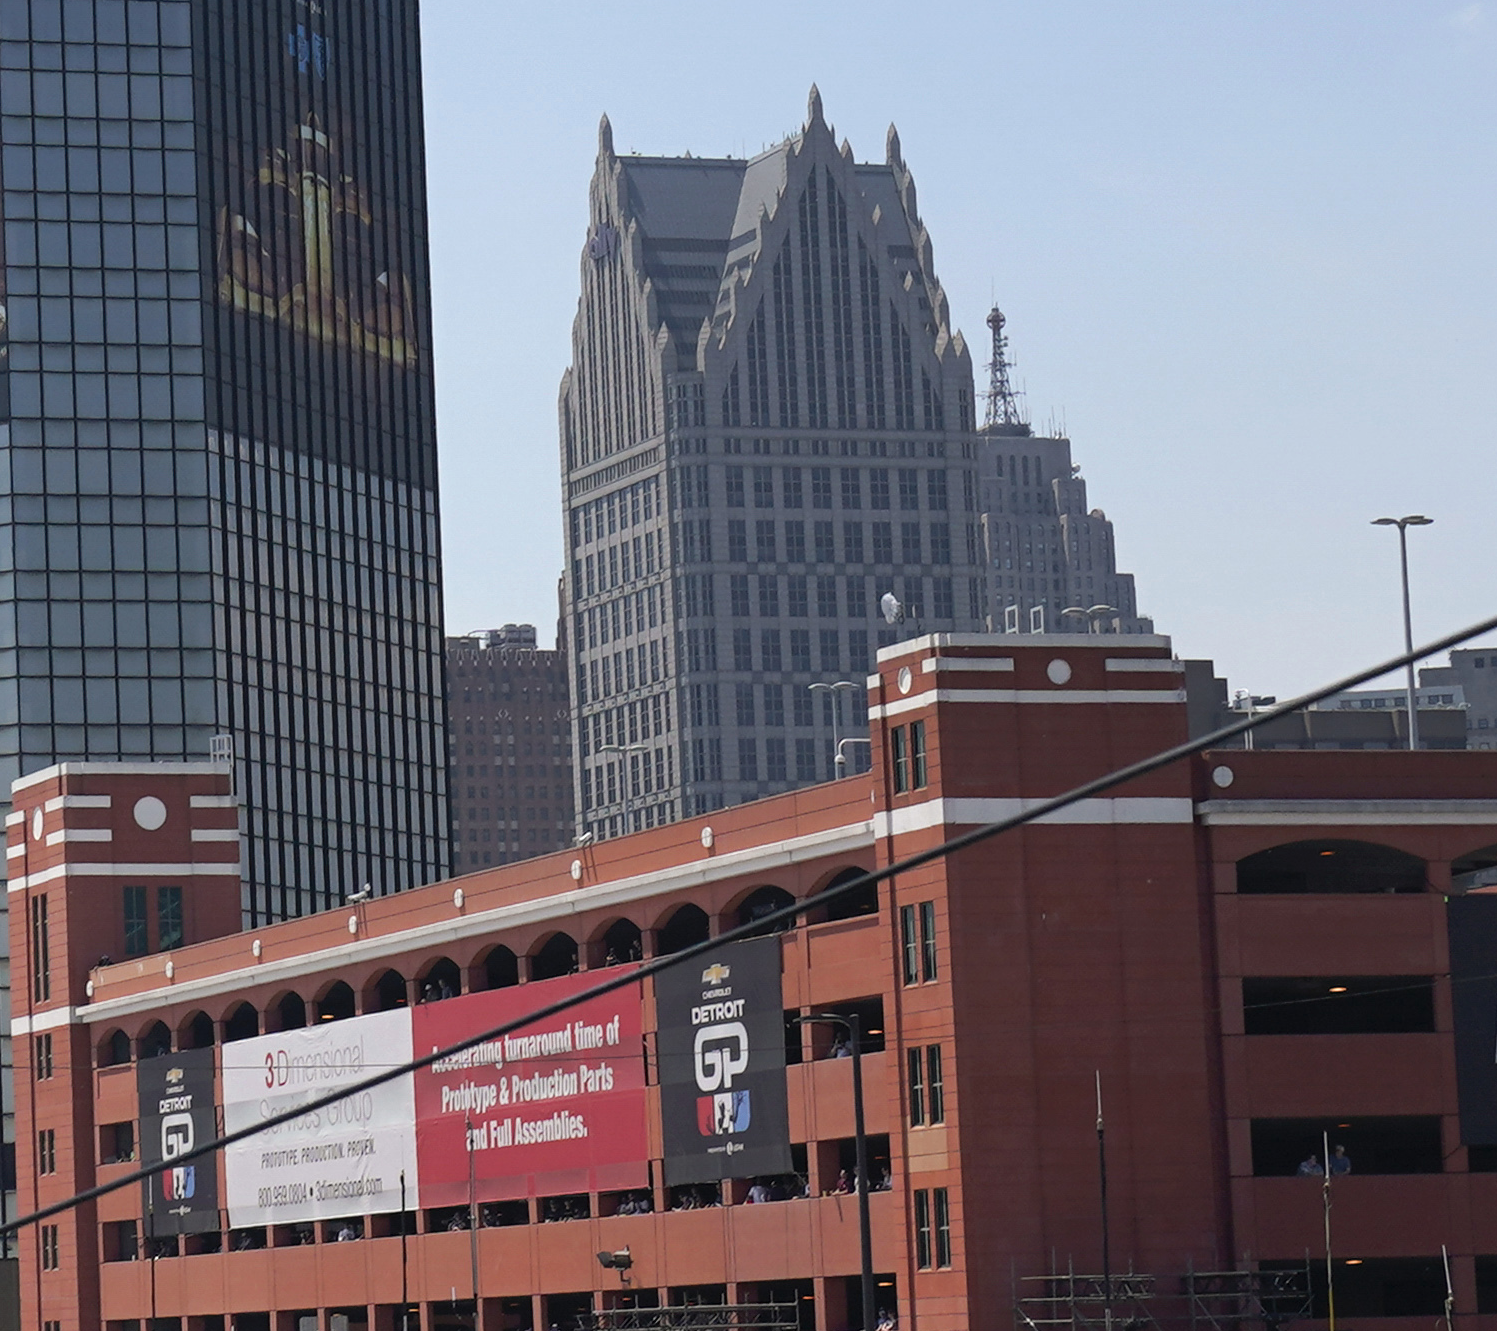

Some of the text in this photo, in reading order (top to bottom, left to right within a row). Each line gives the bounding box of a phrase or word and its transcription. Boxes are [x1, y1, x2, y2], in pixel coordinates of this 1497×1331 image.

[691, 999, 745, 1025] DETROIT
[504, 1023, 573, 1062] turnaround
[575, 1021, 604, 1050] time
[606, 1015, 620, 1046] of
[694, 1022, 749, 1092] GP
[159, 1095, 193, 1114] DETROIT
[442, 1062, 614, 1115] Prototype & Production Parts
[161, 1113, 195, 1162] GP
[466, 1111, 588, 1152] and Full Assemblies.
